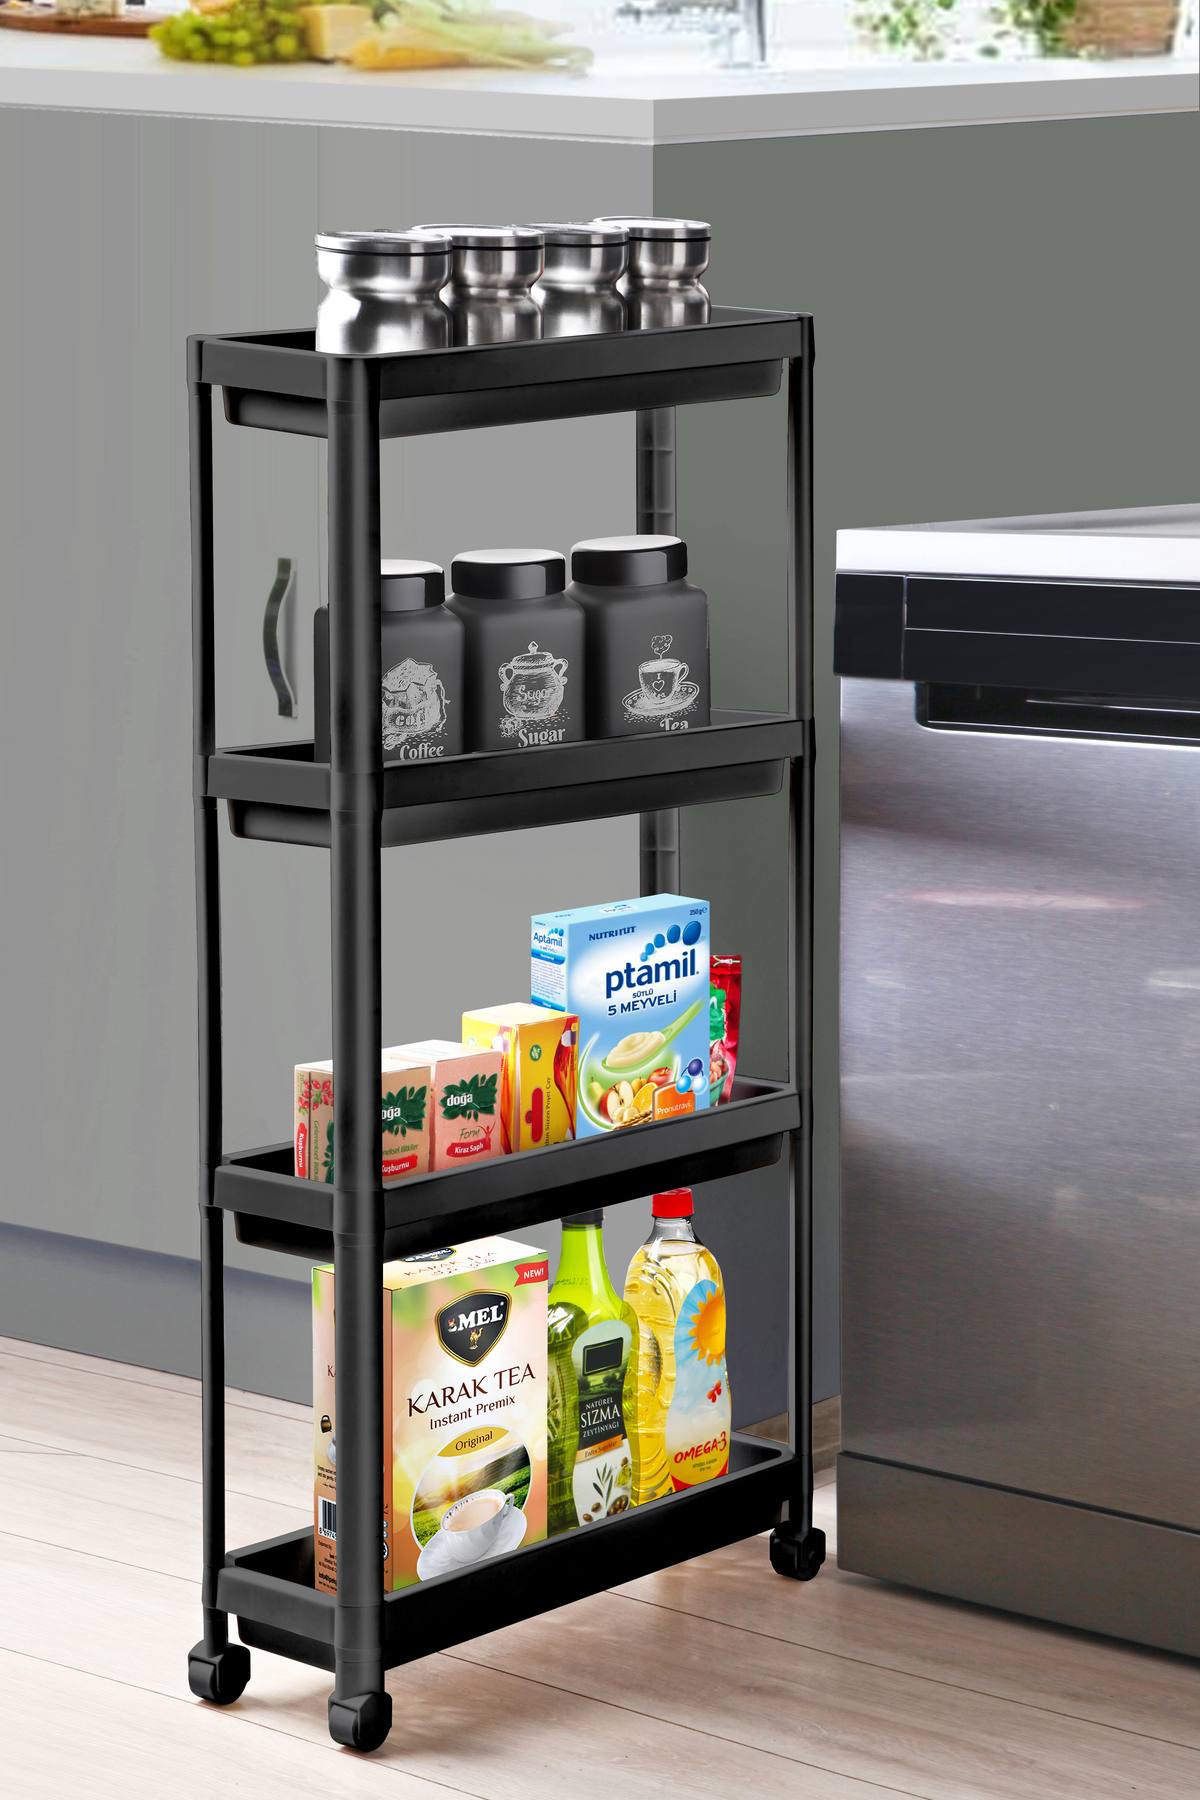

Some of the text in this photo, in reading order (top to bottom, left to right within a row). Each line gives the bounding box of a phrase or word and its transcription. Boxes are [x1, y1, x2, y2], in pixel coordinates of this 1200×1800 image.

[660, 717, 689, 731] Tea
[518, 728, 566, 748] Sugar
[400, 742, 445, 761] Coffee
[533, 932, 563, 948] Aptamil
[632, 988, 654, 998] SÜTLÜ
[607, 989, 677, 1017] 5 MEYVELİ
[446, 1093, 473, 1107] doğa
[382, 1107, 401, 1121] oğa
[454, 1142, 484, 1154] Kiraz Saplı
[523, 1267, 544, 1280] NEW!
[406, 1363, 536, 1418] KARAK TEA
[430, 1395, 516, 1430] Instant Premix
[580, 1403, 621, 1428] SIZMA
[455, 1430, 493, 1451] Original
[673, 1430, 727, 1464] OMEGA-3
